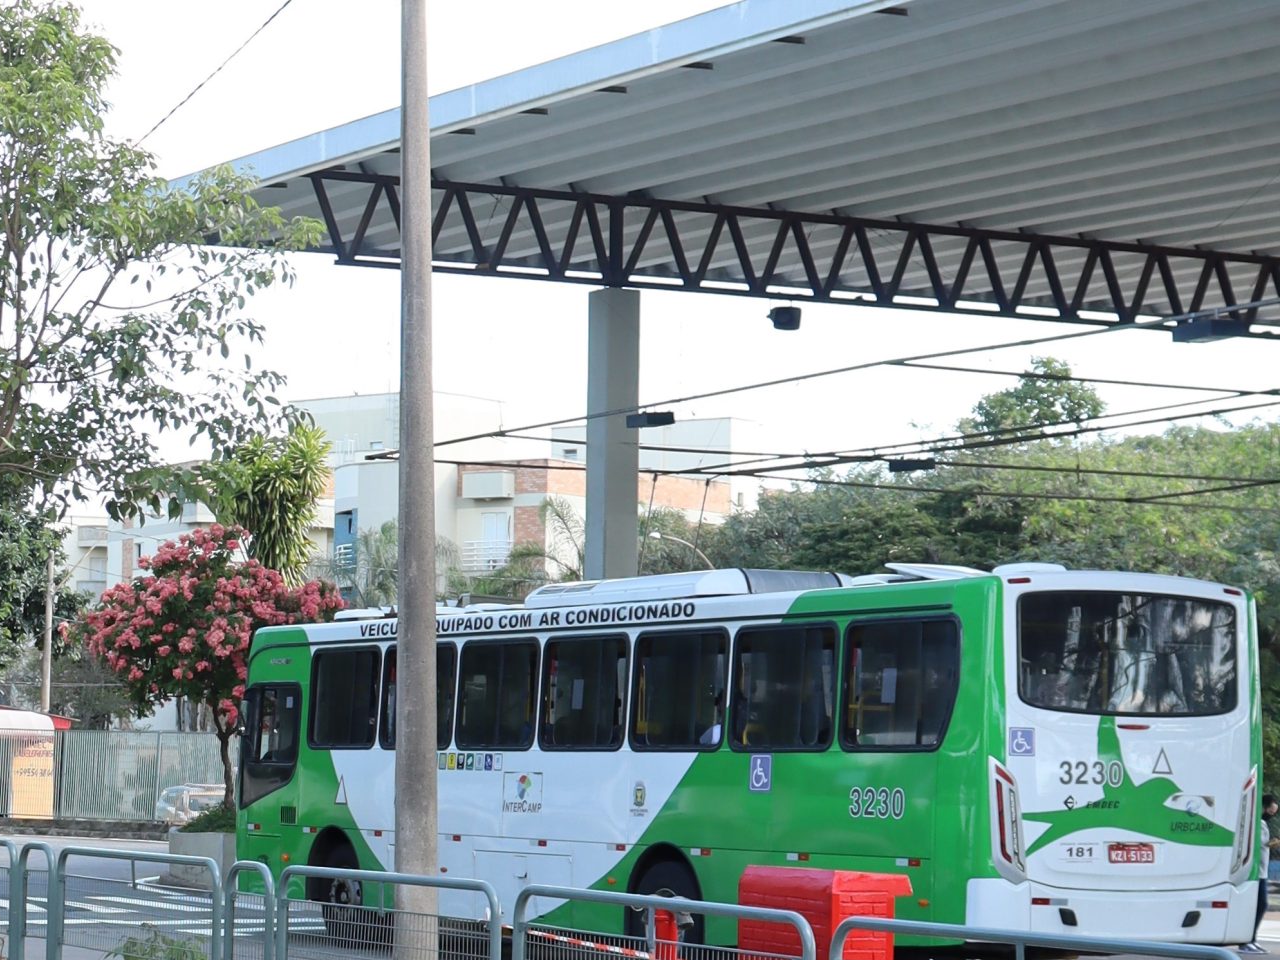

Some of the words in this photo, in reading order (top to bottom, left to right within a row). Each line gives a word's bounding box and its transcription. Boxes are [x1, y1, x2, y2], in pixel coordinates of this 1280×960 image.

[360, 621, 398, 638] VEICU
[498, 613, 532, 629] COM
[539, 611, 560, 627] AR
[565, 602, 696, 625] CONDICIONADO
[1059, 760, 1124, 788] 3230
[849, 786, 905, 820] 3230
[1085, 800, 1120, 809] EMDEC
[1170, 821, 1214, 833] URBCAMP
[1066, 847, 1094, 858] 181
